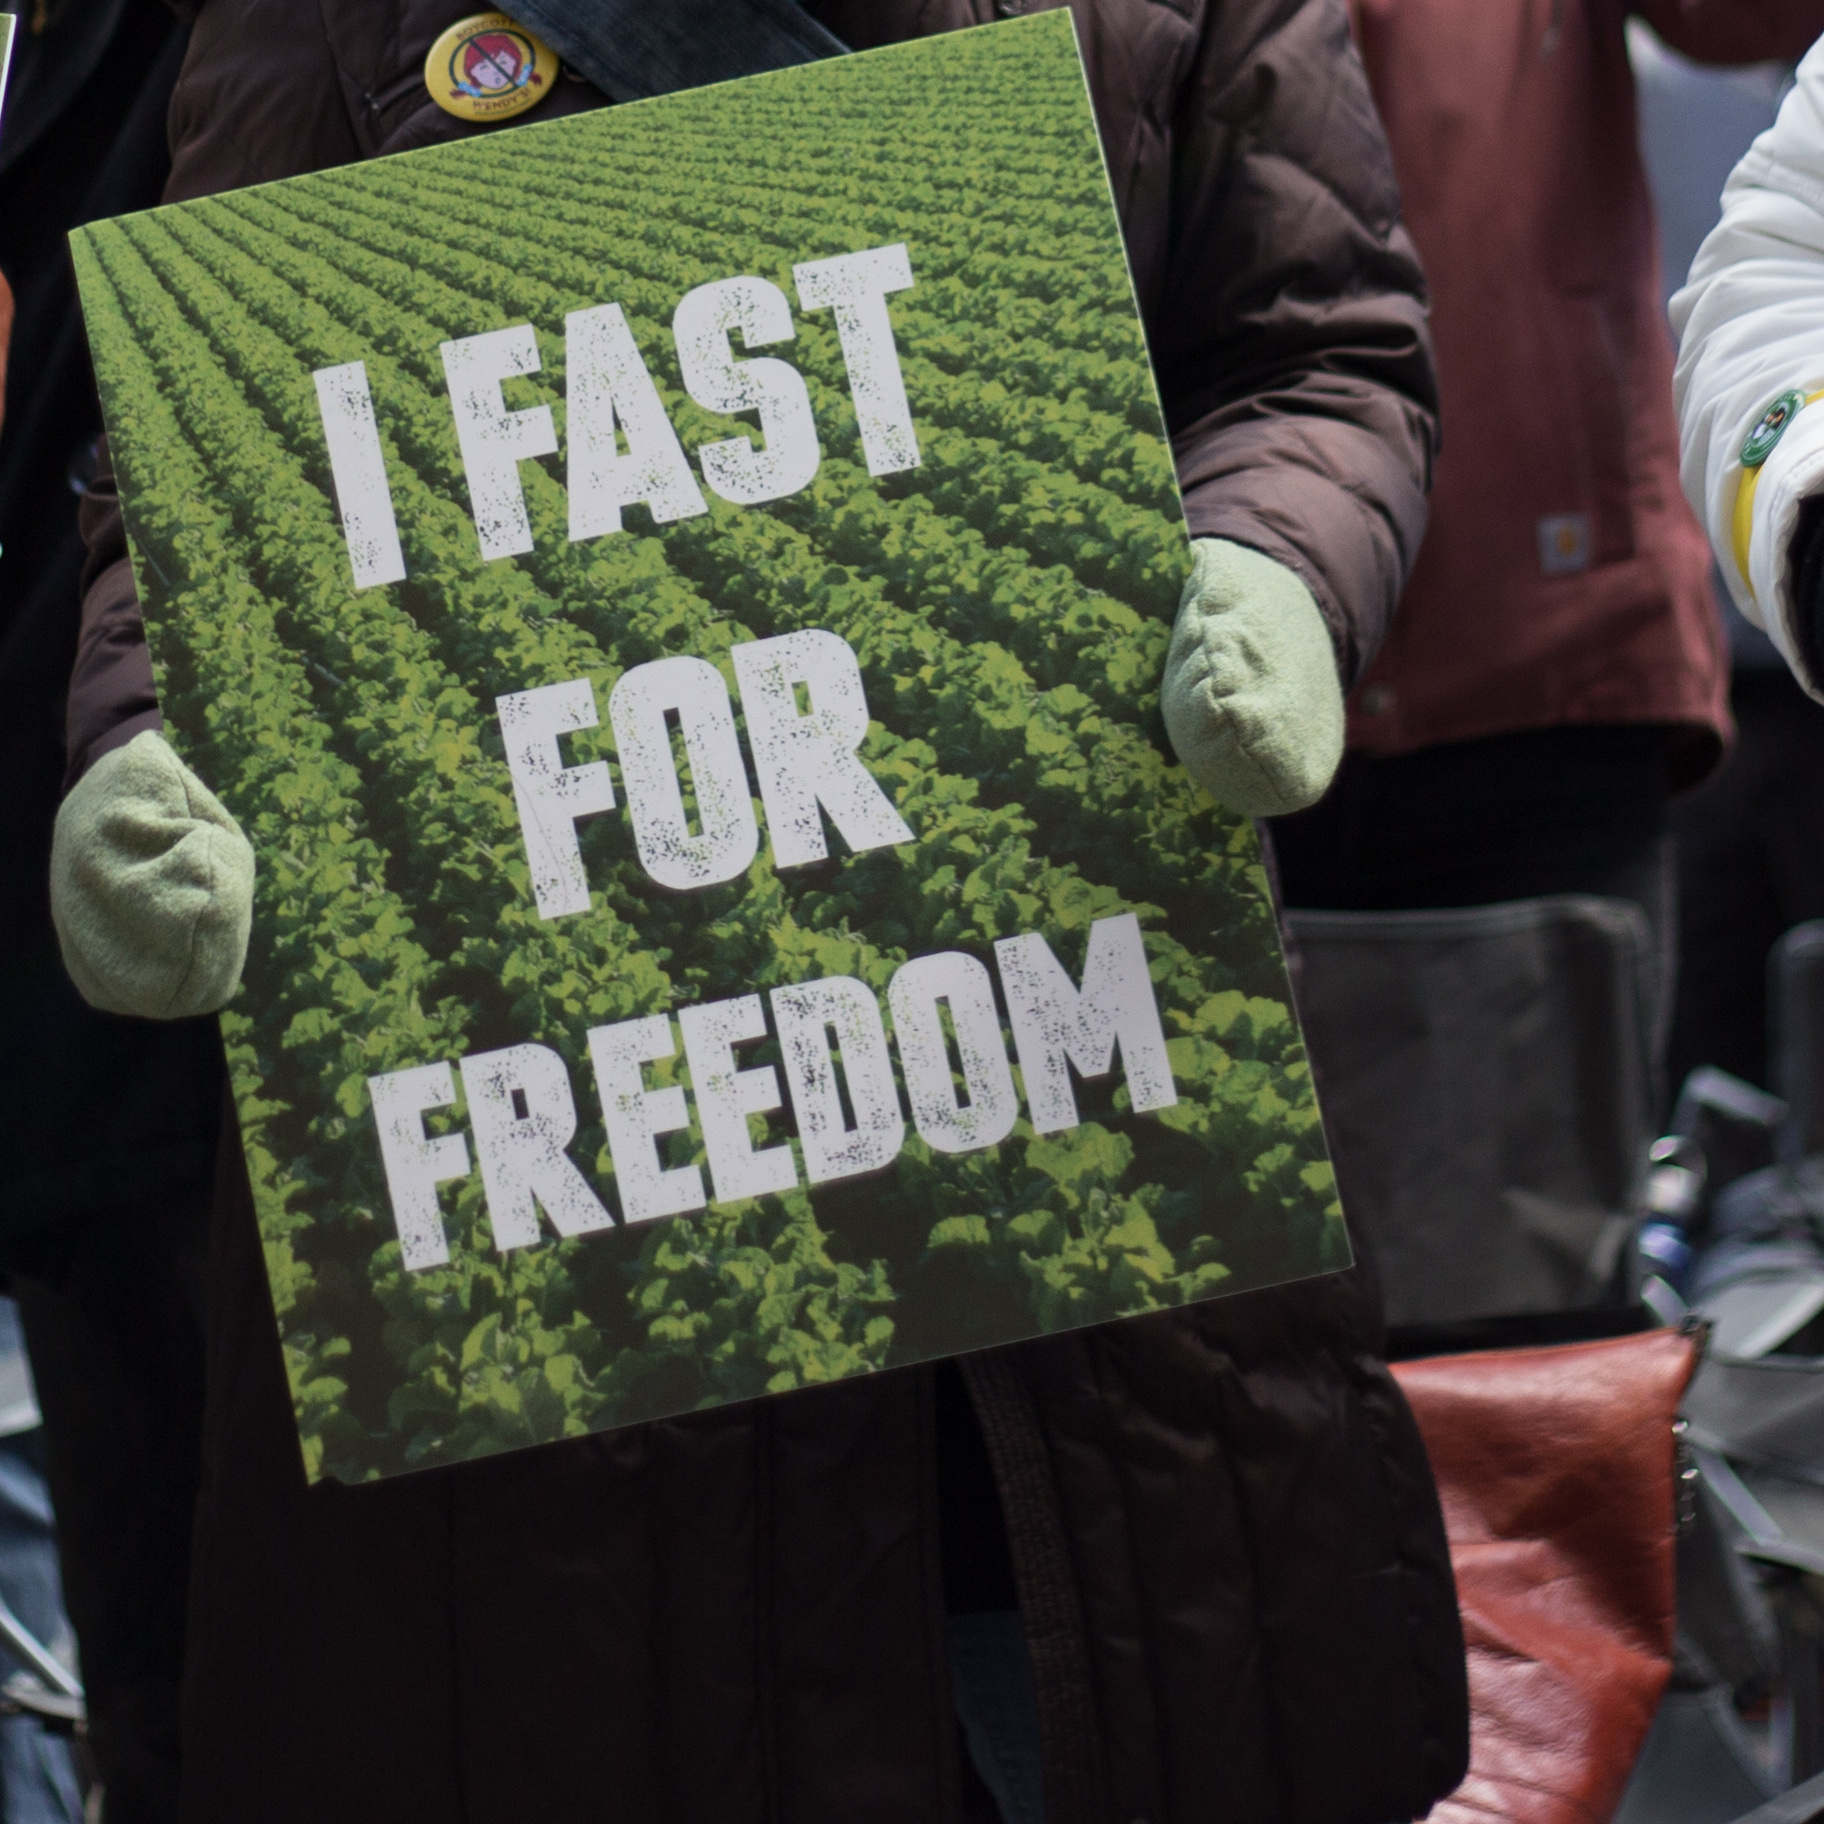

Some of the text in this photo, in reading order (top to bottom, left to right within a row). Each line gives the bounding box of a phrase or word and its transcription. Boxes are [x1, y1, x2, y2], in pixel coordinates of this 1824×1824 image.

[311, 242, 921, 591] I FAST
[494, 627, 916, 922] FOR
[368, 910, 1178, 1273] FREEDOM
